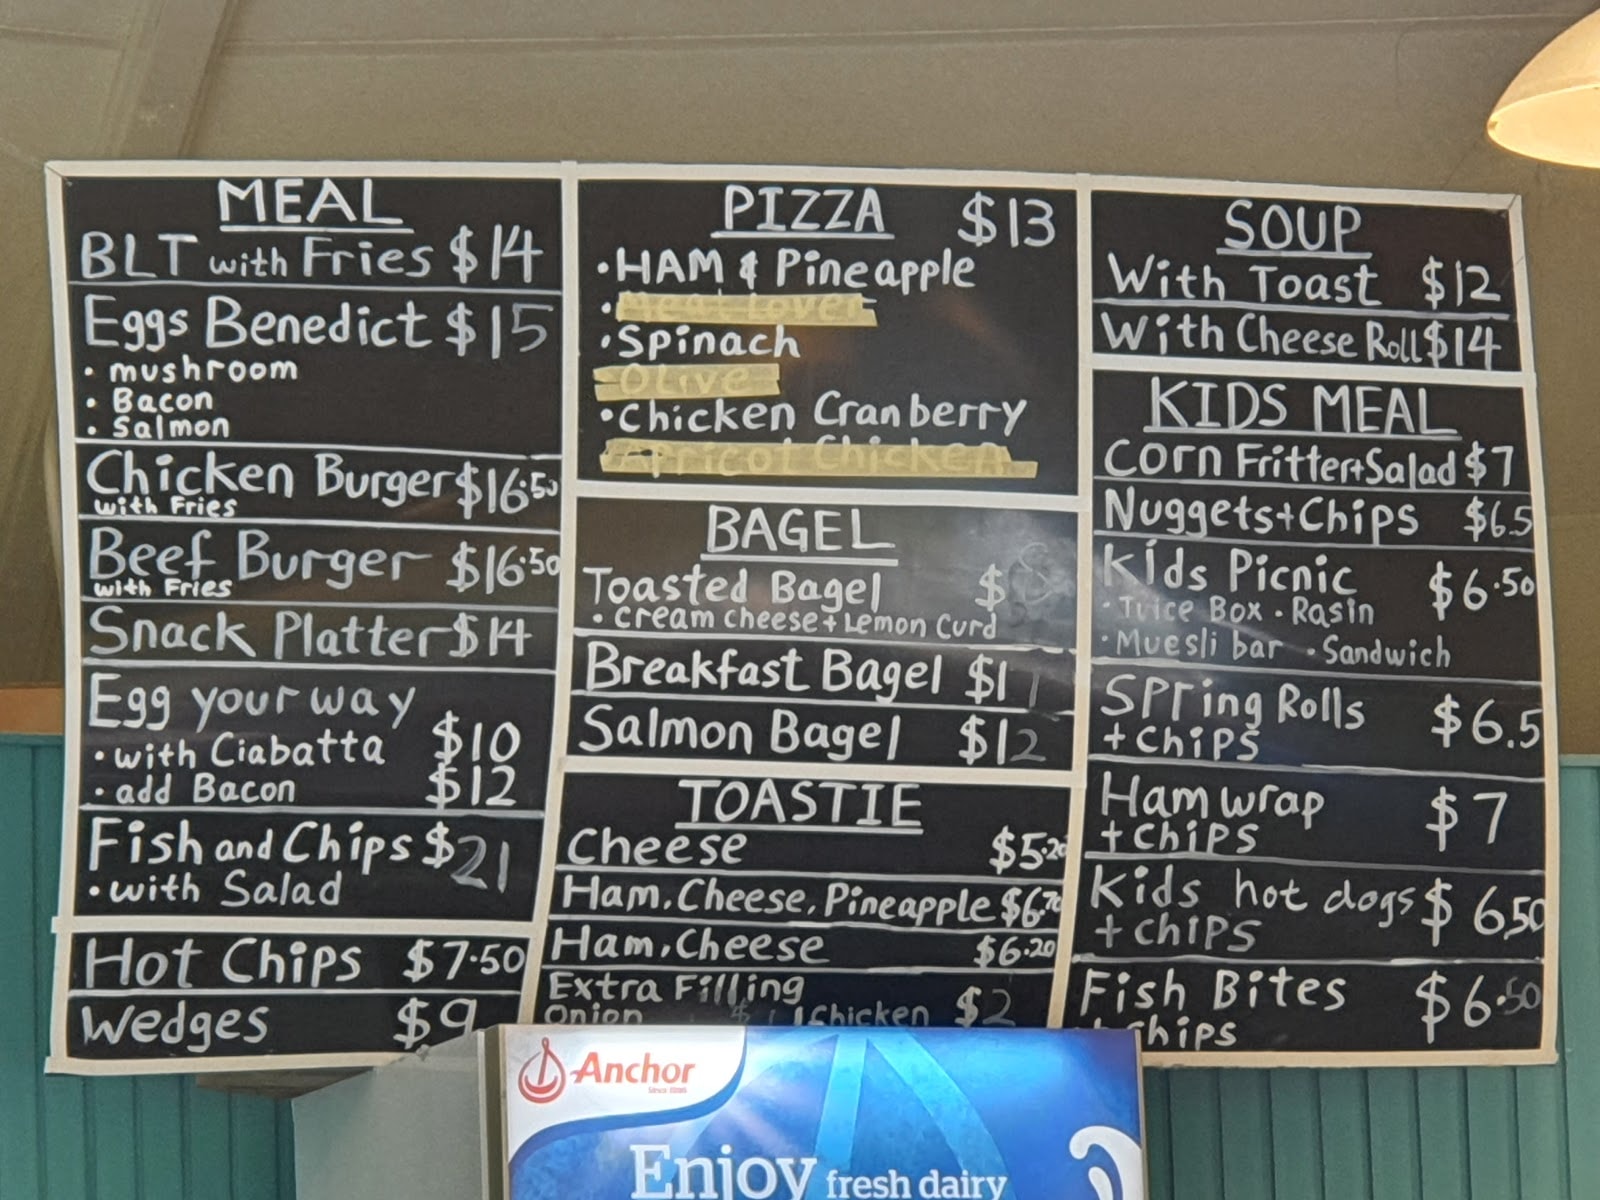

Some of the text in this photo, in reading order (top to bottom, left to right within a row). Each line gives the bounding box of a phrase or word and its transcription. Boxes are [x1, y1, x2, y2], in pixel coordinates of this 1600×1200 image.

[217, 178, 404, 225] MEAL
[723, 184, 1056, 248] PIZZA $13
[1223, 200, 1361, 254] SOUP
[80, 225, 545, 284] BLT with Fries $14
[616, 248, 725, 284] HAM
[777, 247, 977, 294] Pineapple
[1108, 253, 1501, 309] With Toast $12
[84, 294, 554, 360] Eggs Benedict $15
[617, 324, 800, 360] Spinach
[1101, 313, 1501, 369] With Cheese Roll $14
[110, 354, 298, 384] mushroom
[112, 387, 214, 413] Bacon
[618, 390, 1028, 437] Chicken Cranberry
[1150, 376, 1458, 435] KIDS MEAL
[112, 414, 230, 440] Salmon
[86, 450, 294, 499] Chicken
[314, 453, 455, 508] Burger
[1104, 439, 1221, 477] Corn
[1464, 440, 1514, 487] $7
[95, 496, 238, 518] with Fries
[707, 504, 896, 552] BAGEL
[90, 527, 215, 581] Beef
[238, 529, 433, 590] Burger
[1103, 541, 1208, 589] Kids
[1230, 548, 1358, 597] Picnic
[94, 578, 232, 599] with Fries
[582, 564, 748, 604] Toasted
[770, 569, 881, 612] Bagel
[1209, 594, 1263, 624] Box
[1292, 597, 1375, 629] Rasin
[89, 605, 532, 661] Snack Platter $14
[615, 607, 714, 630] cream
[936, 612, 996, 639] Curd
[1117, 625, 1451, 668] Muesli bar Sandwich
[586, 641, 809, 693] Breakfast
[822, 647, 942, 703] Bagel
[89, 673, 416, 733] Egg your way
[1278, 683, 1366, 729] Rolls
[114, 710, 521, 770] with Ciabatta $10
[579, 703, 753, 755] Salmon
[769, 708, 902, 762] Bagel
[116, 762, 517, 810] add Bacon $12
[678, 778, 921, 827] TOASTIE
[1101, 771, 1209, 818] Ham
[1221, 785, 1325, 829] wrap
[90, 816, 203, 872] Fish
[215, 829, 274, 860] and
[283, 821, 414, 875] Chips
[567, 828, 748, 865] Cheese
[109, 871, 343, 908] with Salad
[824, 882, 996, 927] Pineapple
[1090, 864, 1202, 909] Kids
[1236, 868, 1308, 911] hot
[1323, 879, 1417, 928] dogs
[85, 937, 203, 990] Hot
[222, 938, 363, 988] Chips
[676, 927, 830, 963] Cheese
[550, 971, 662, 1002] Extra
[1080, 967, 1187, 1017] Fish
[1213, 967, 1347, 1012] Bites
[81, 997, 477, 1053] Wedges $9
[570, 1051, 697, 1084] Anchor
[629, 1143, 1008, 1200] Enjoy fresh dairy
